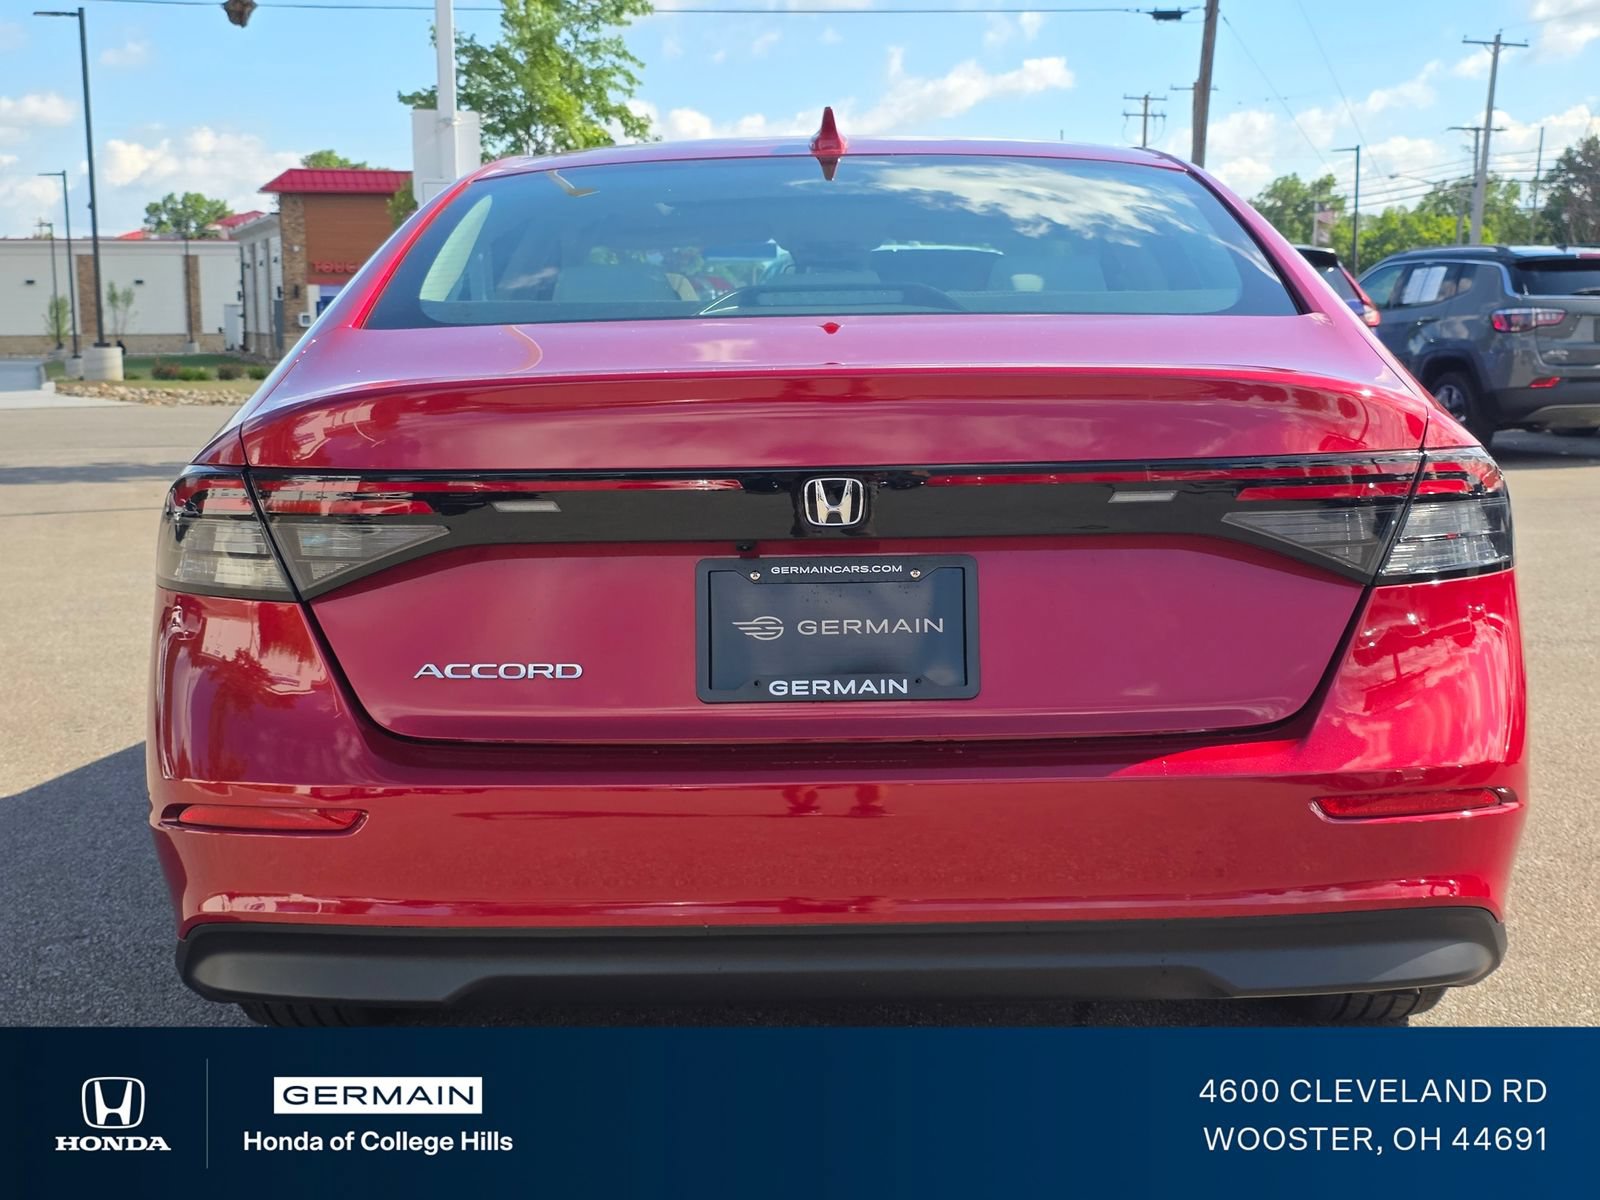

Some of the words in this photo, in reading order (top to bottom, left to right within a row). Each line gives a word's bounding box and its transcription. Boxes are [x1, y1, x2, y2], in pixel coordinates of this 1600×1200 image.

[770, 564, 903, 575] GERMAINCARS.COM
[797, 617, 944, 636] GERMAIN
[413, 663, 583, 679] ACCORD
[768, 678, 908, 696] GERMAIN
